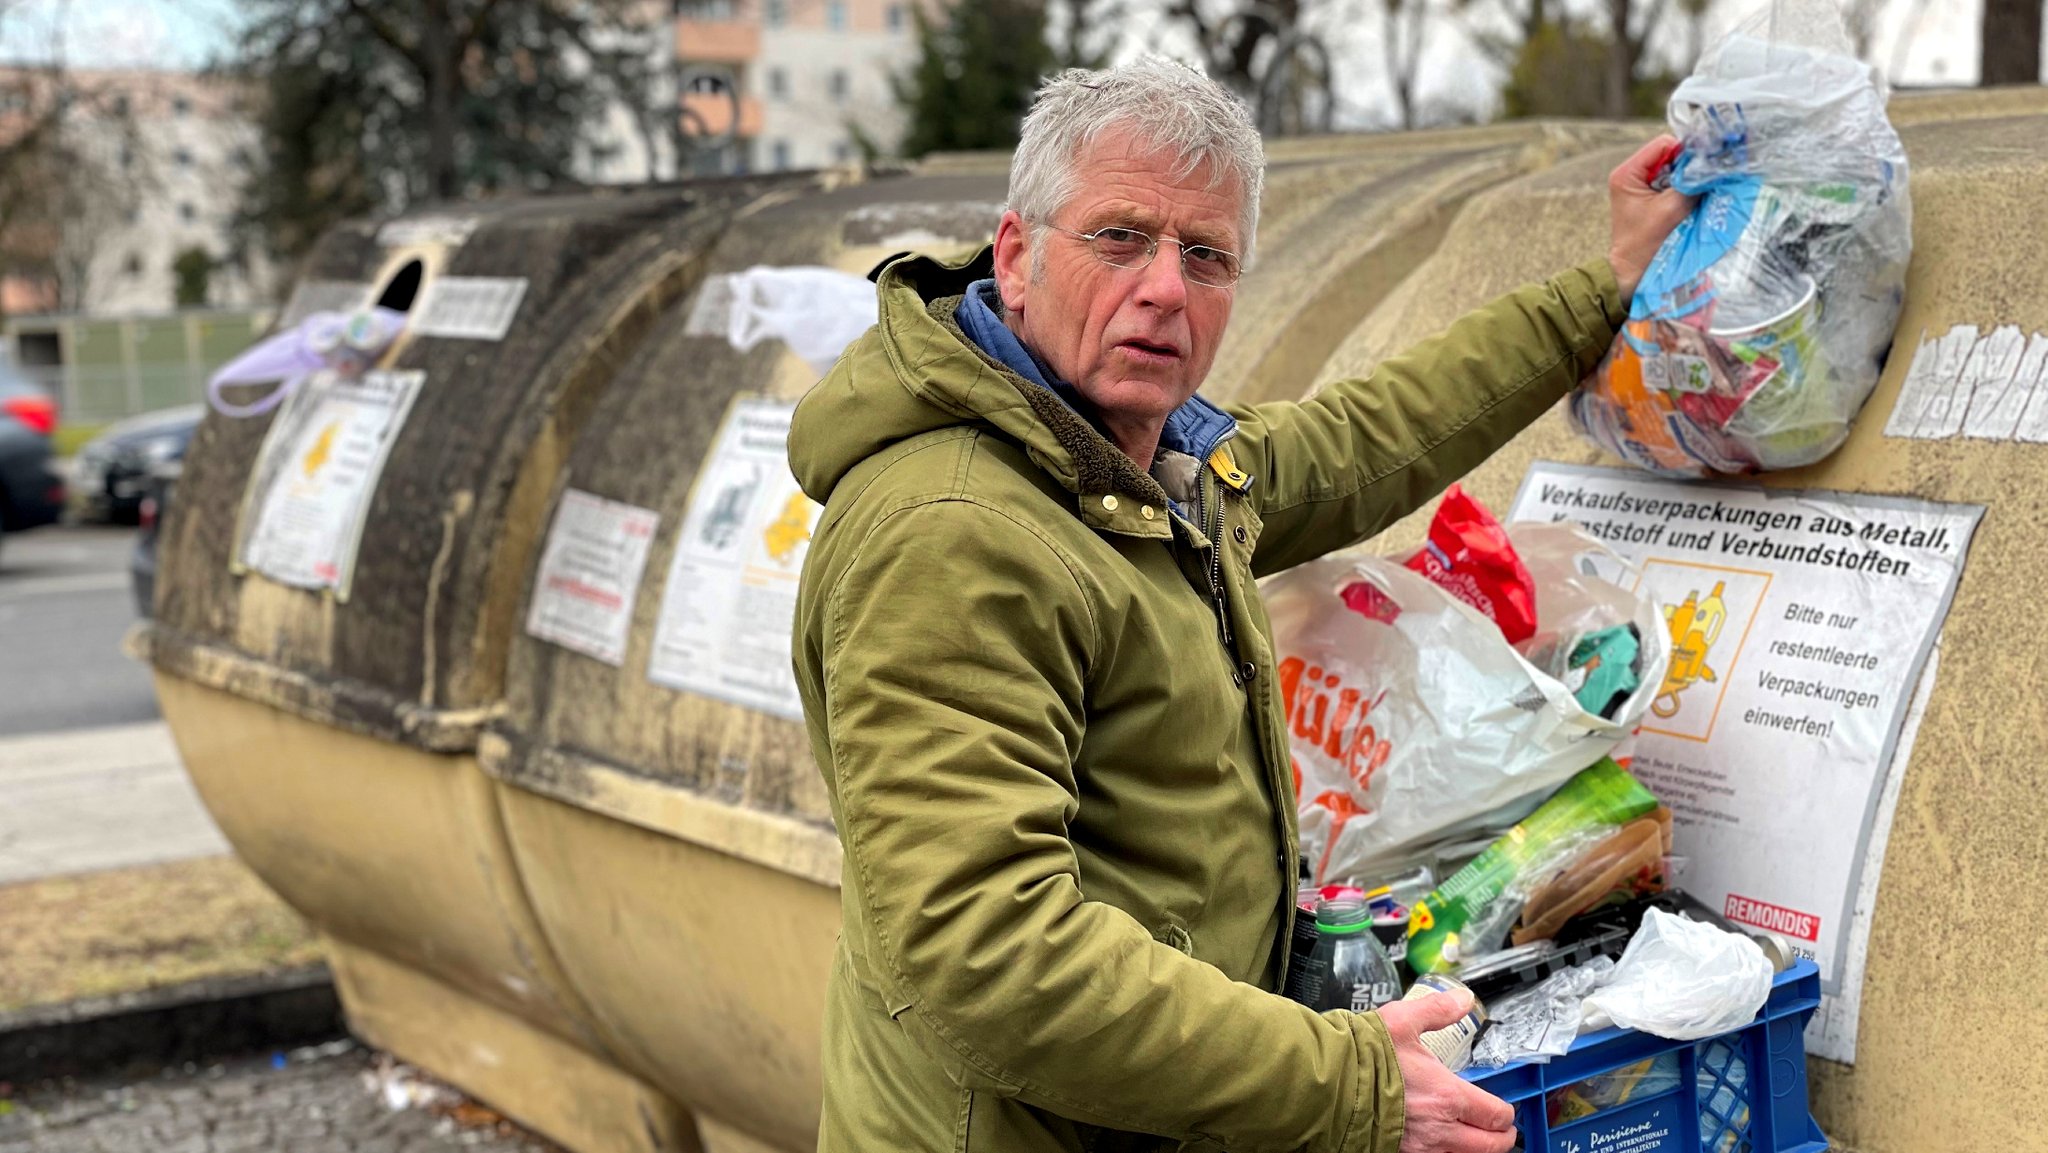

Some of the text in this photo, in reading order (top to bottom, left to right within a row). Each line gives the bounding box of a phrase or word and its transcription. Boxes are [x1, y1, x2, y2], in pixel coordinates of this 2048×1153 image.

[1540, 483, 1951, 552] Verkaufsverpackungen aus Metall,
[1552, 512, 1911, 577] Knststoff und Verbundstoffen
[1783, 602, 1859, 630] Bitte nur
[1769, 640, 1879, 671] restentleerte
[1757, 670, 1880, 710] Verpackungen
[1743, 707, 1834, 738] einwerfen!
[1726, 897, 1812, 938] REMONDIS
[1615, 1128, 1669, 1150] INTERNATIONALE
